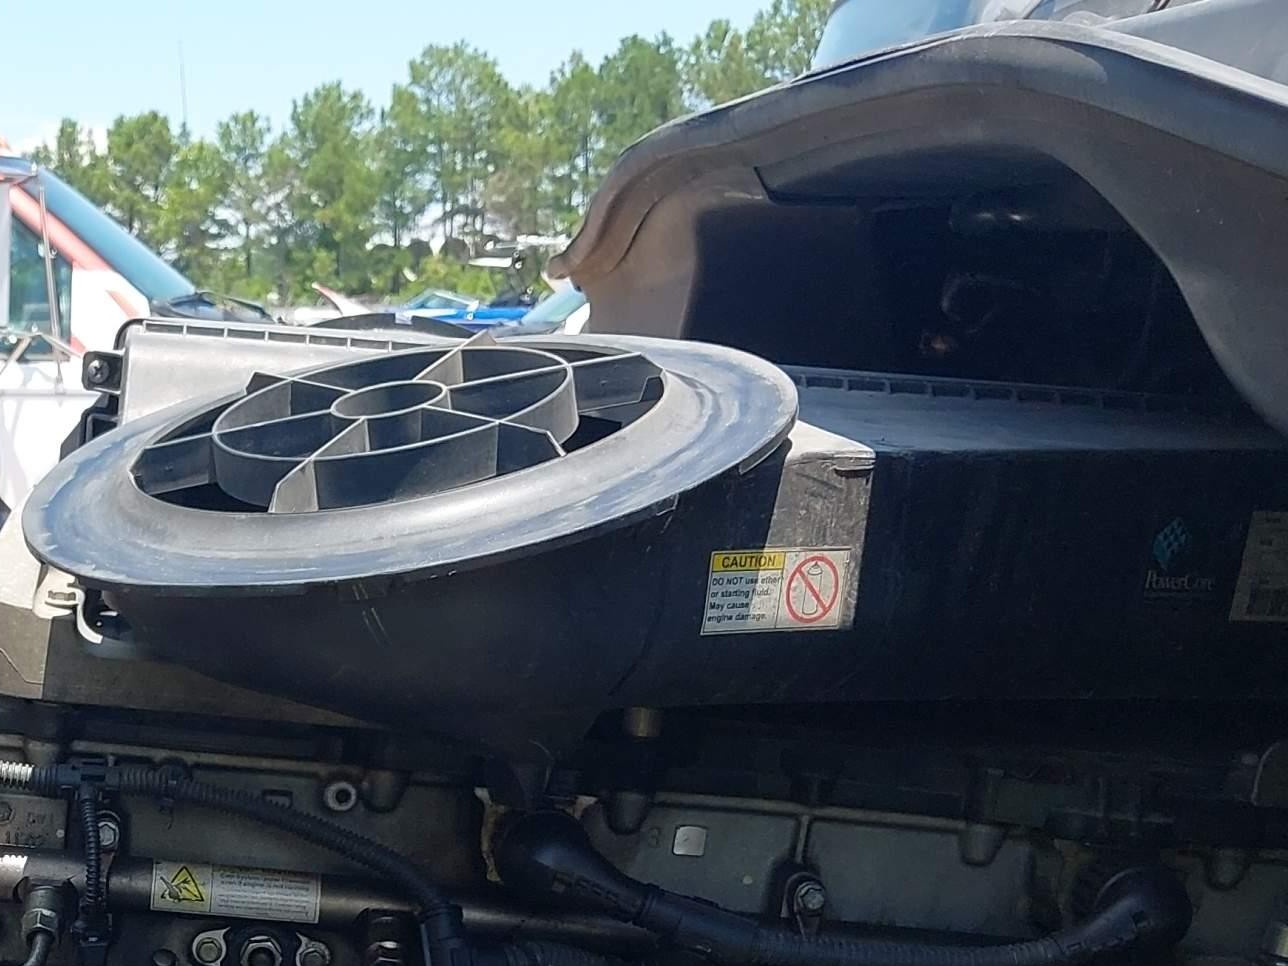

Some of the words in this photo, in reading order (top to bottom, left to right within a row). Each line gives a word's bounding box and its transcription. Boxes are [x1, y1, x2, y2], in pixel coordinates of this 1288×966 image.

[722, 555, 776, 568] CAUTION
[712, 577, 724, 586] DO
[726, 576, 744, 586] NOT
[745, 577, 758, 585] use
[760, 575, 781, 584] ether
[711, 590, 718, 598] or
[720, 589, 750, 599] starting
[709, 602, 725, 611] May
[726, 602, 749, 610] cause
[707, 614, 733, 623] engine
